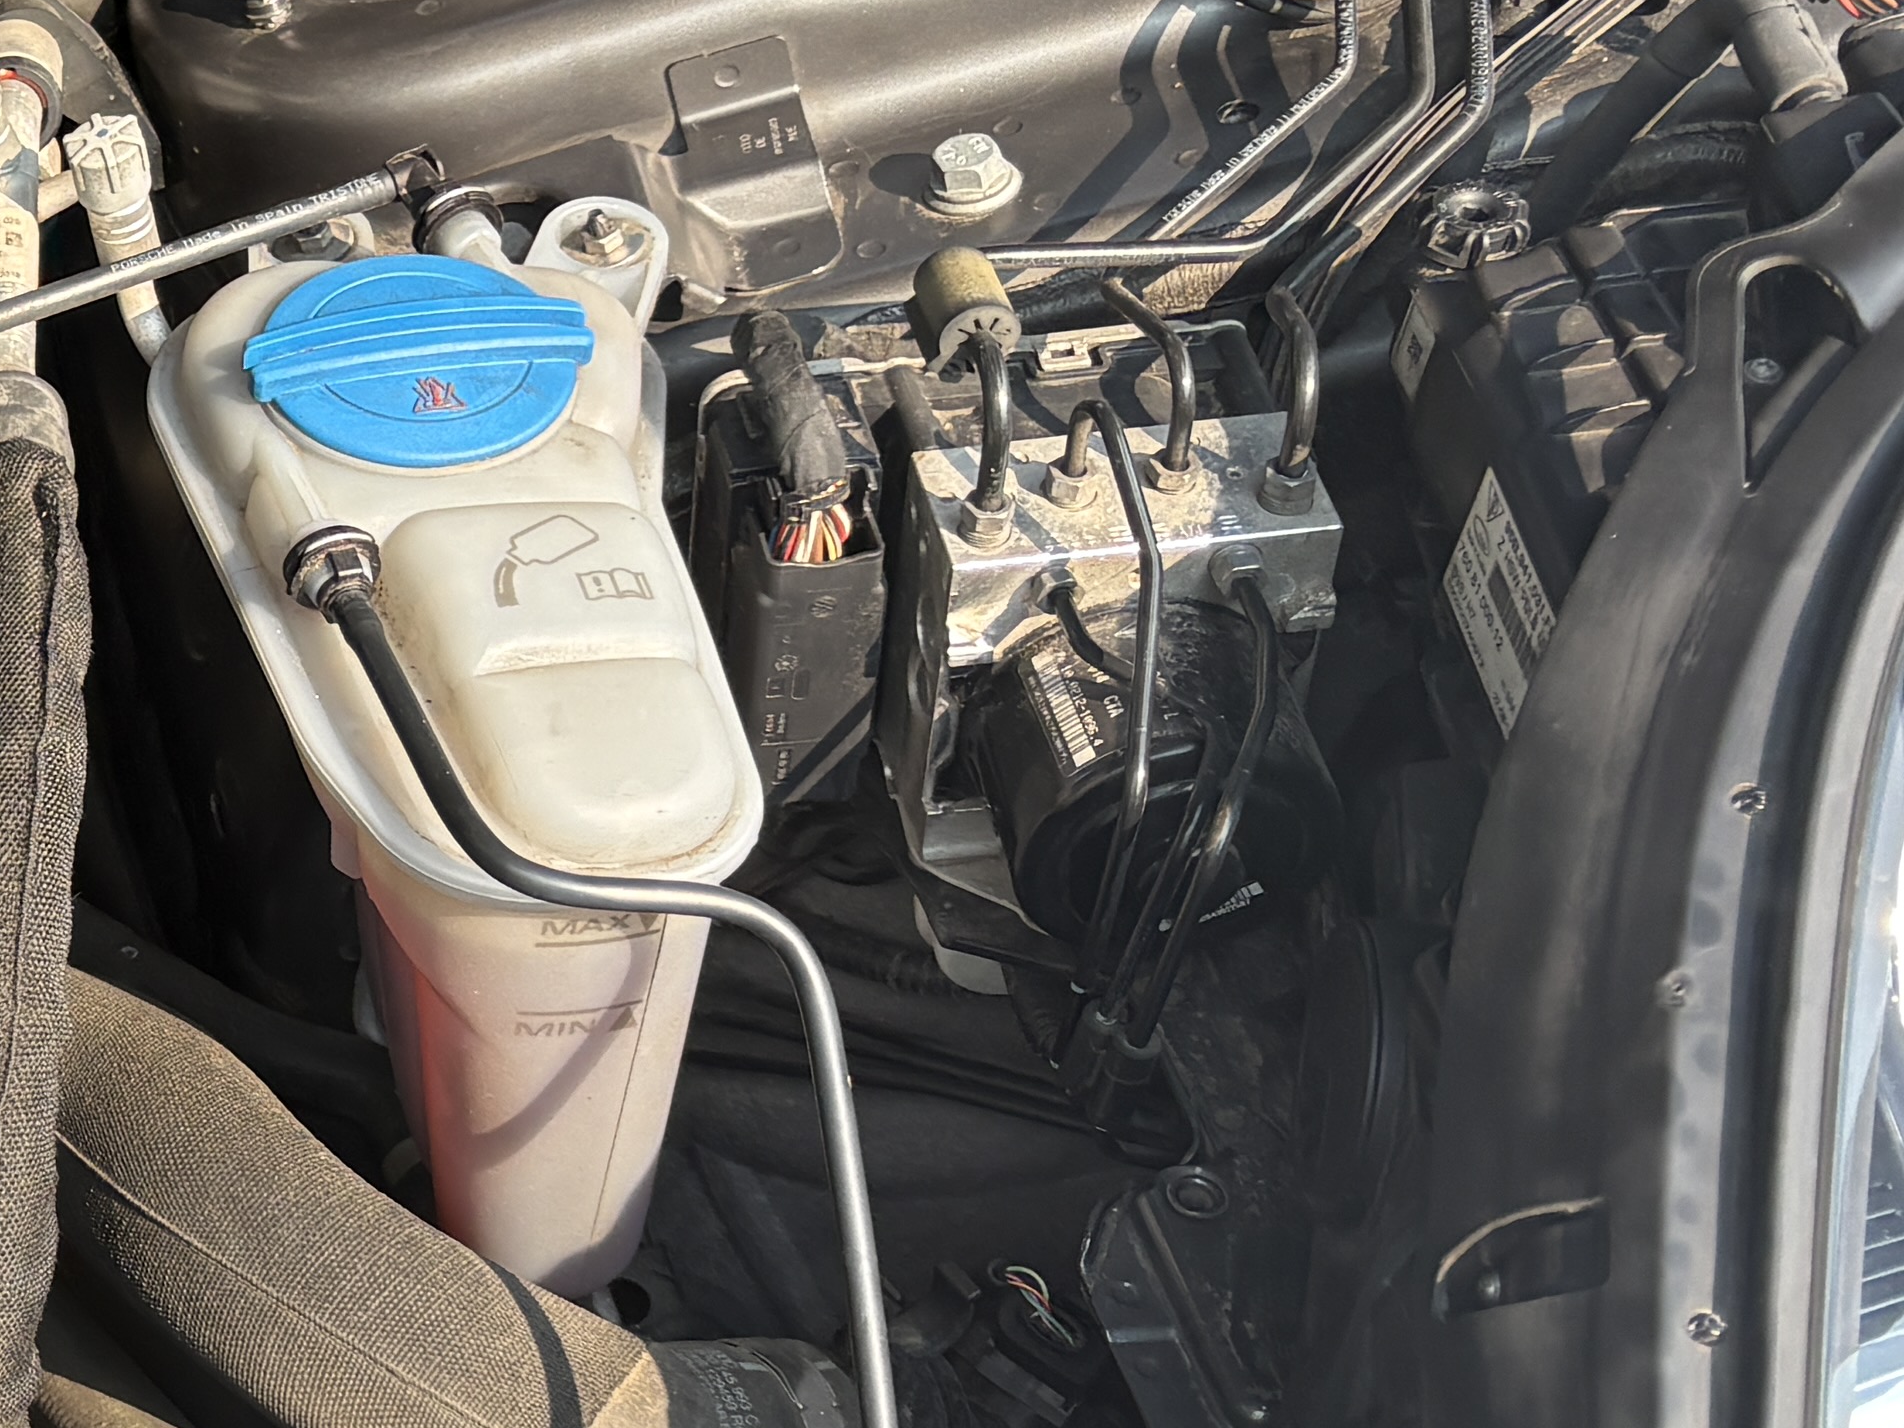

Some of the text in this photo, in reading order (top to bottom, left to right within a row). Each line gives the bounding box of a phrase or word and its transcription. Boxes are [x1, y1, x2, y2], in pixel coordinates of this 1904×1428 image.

[109, 246, 175, 274] PORSCHE
[541, 913, 631, 936] MAX
[514, 1019, 599, 1038] MIN
